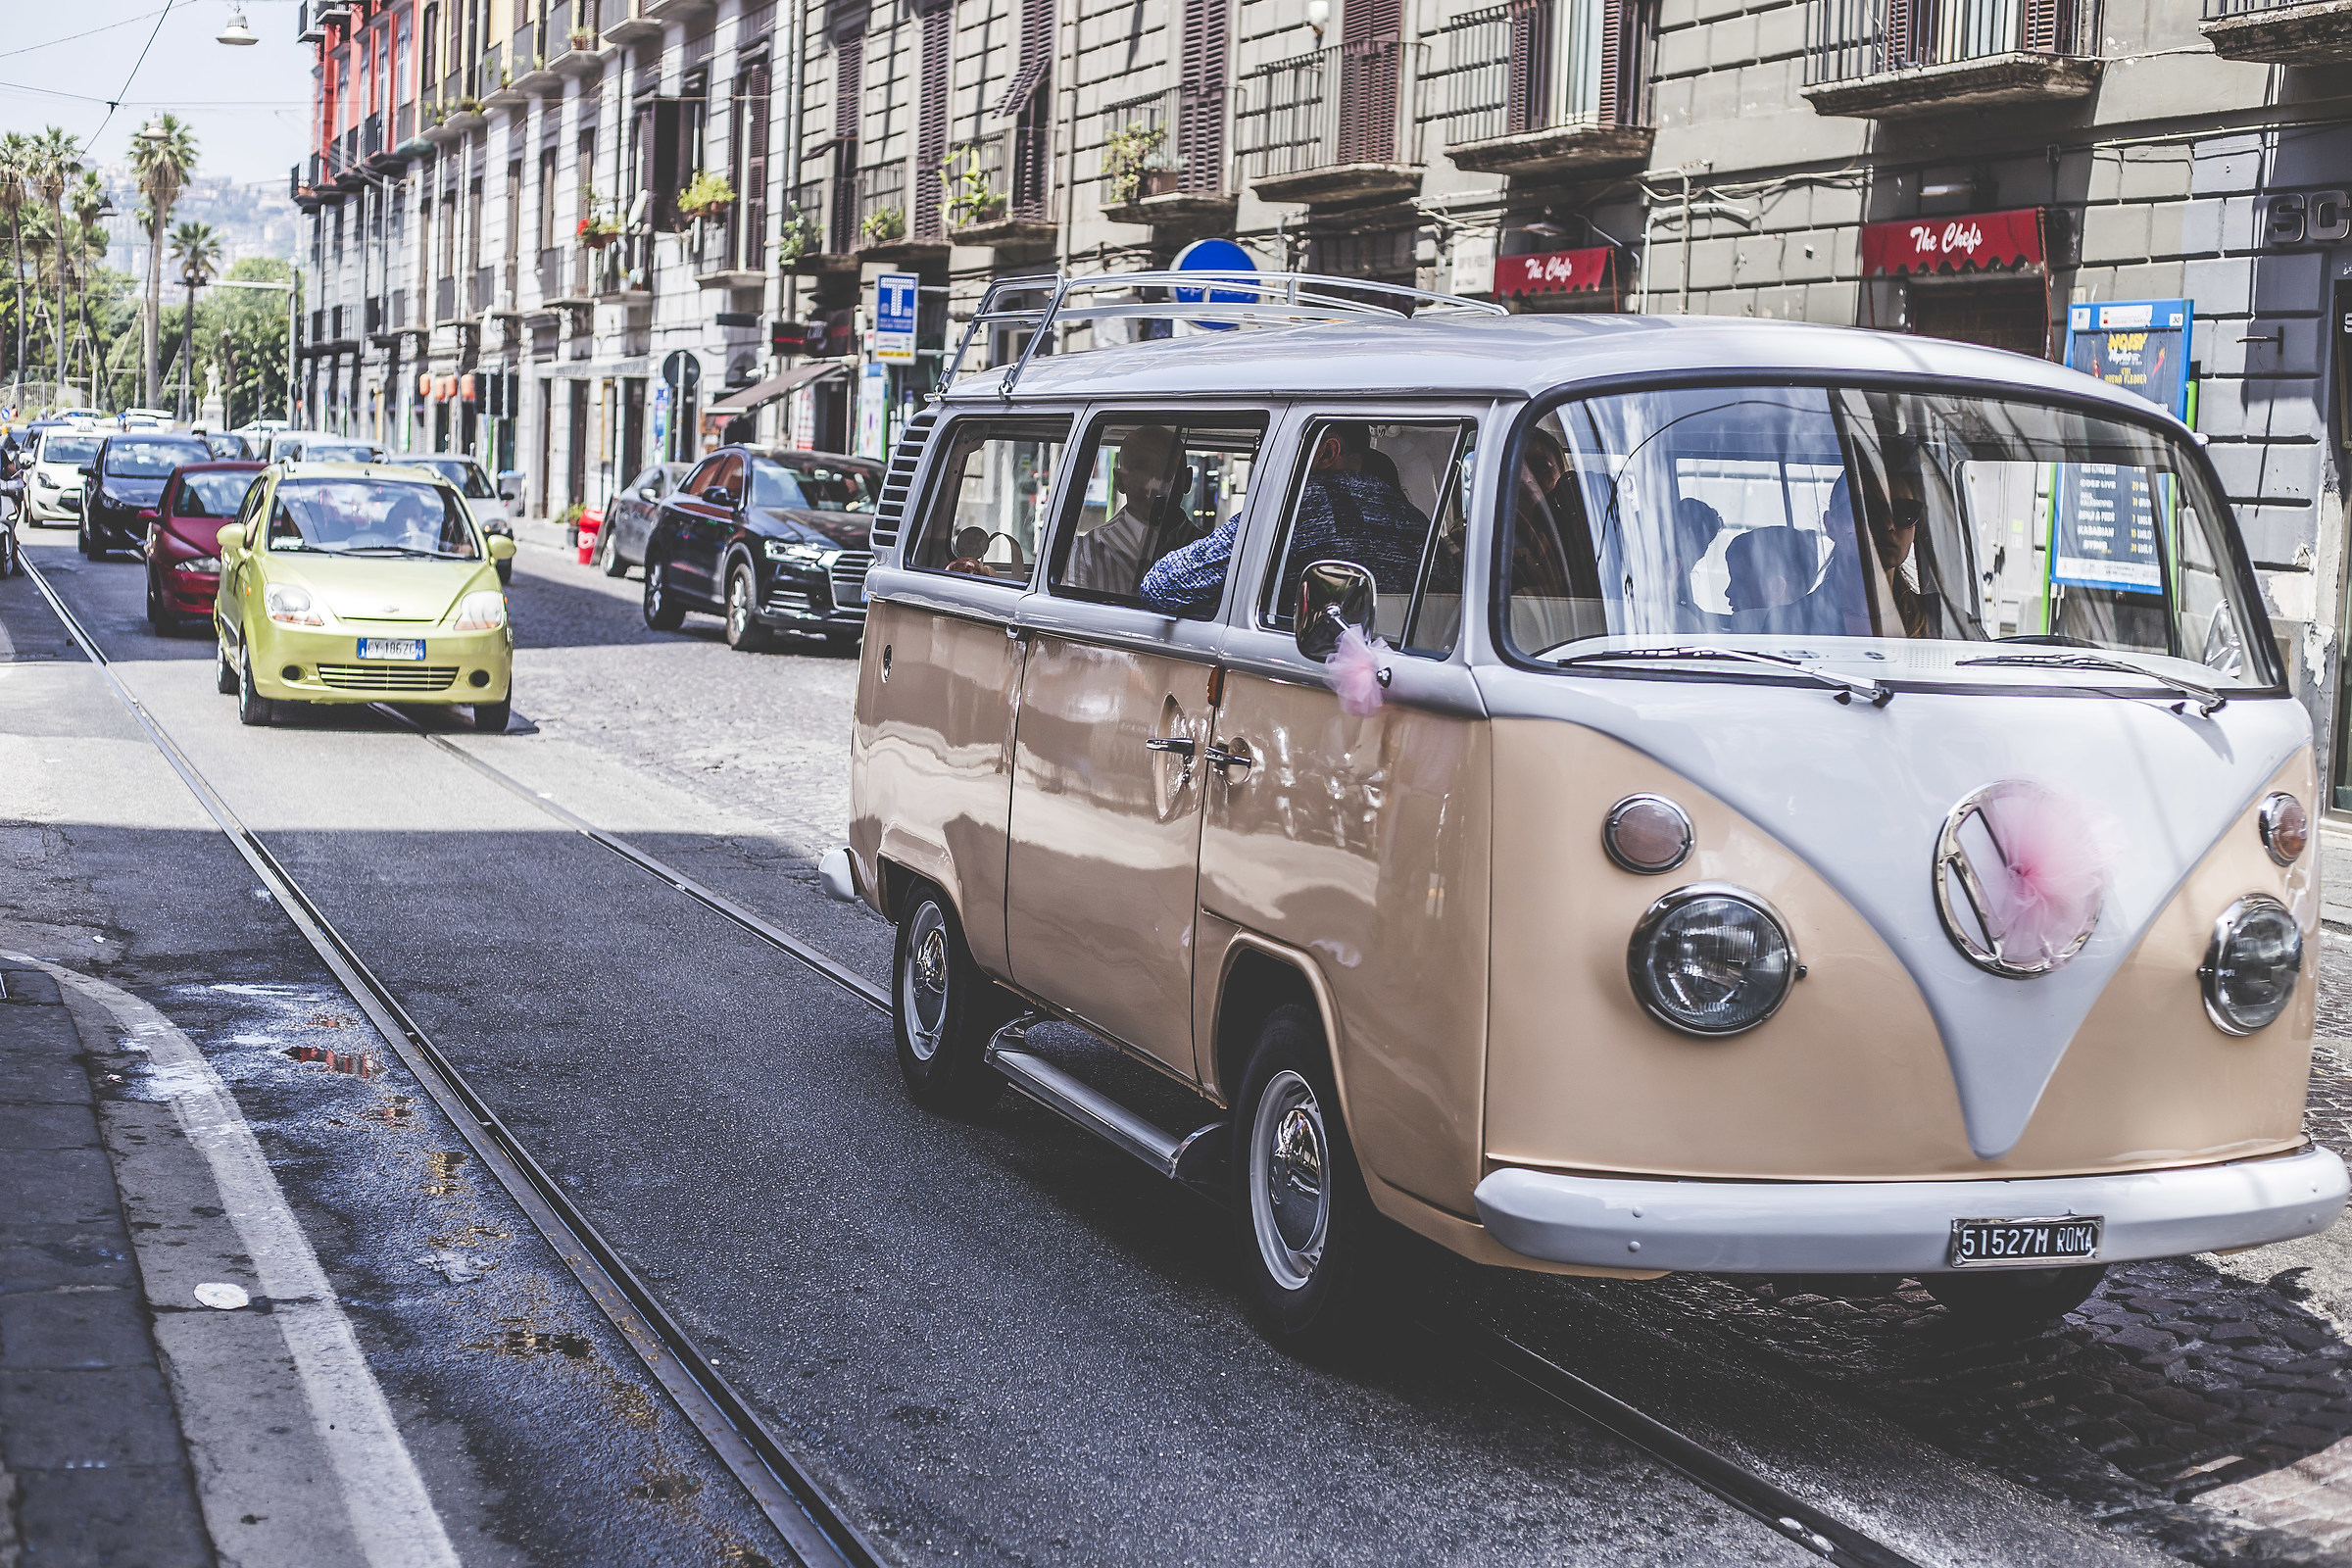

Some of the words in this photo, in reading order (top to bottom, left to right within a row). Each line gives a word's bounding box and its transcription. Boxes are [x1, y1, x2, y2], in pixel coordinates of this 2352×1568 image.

[1910, 225, 1937, 254] The
[1941, 221, 1983, 255] Chefs
[1525, 258, 1544, 280] The
[1545, 256, 1572, 283] Chefs
[880, 277, 915, 317] T
[2107, 333, 2148, 351] NOISY
[1961, 1227, 2049, 1256] 51527M
[2056, 1226, 2094, 1253] ROMA
